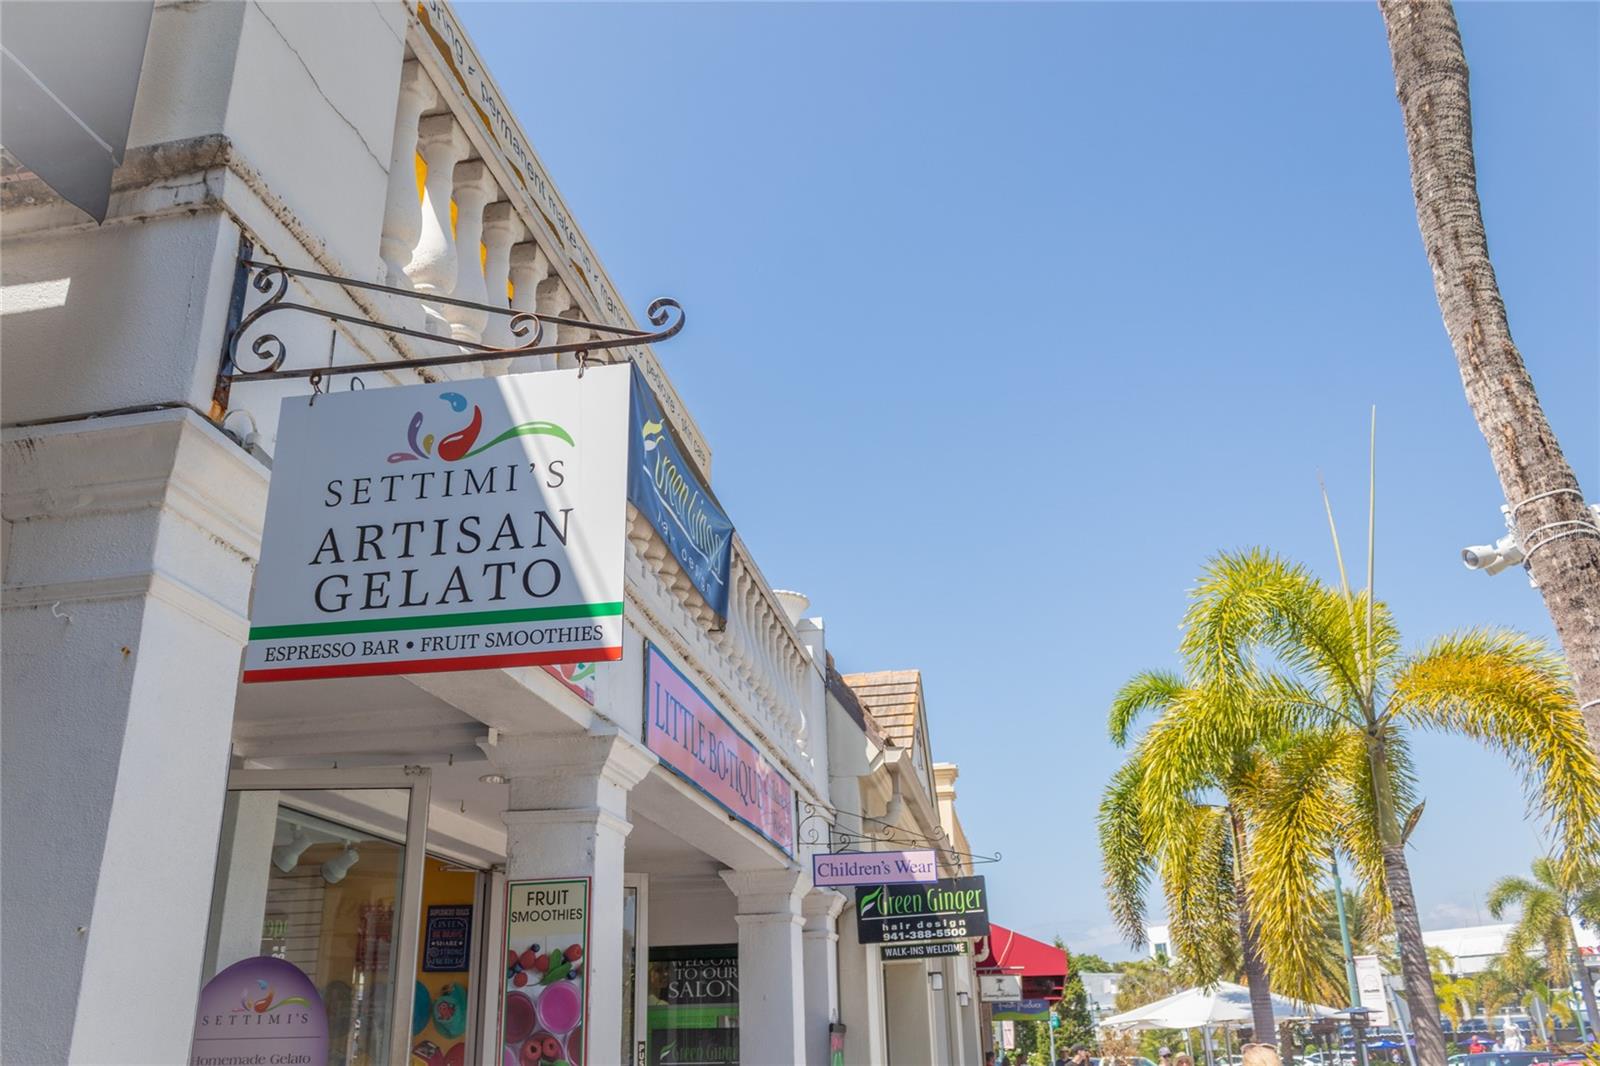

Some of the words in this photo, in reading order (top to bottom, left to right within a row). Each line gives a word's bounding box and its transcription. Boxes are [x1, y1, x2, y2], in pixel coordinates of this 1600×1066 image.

[480, 80, 547, 199] permanent
[324, 460, 566, 507] SETTIMI'S
[308, 508, 574, 566] ARTISAN
[313, 558, 562, 613] GELATO
[264, 641, 356, 662] ESPRESSO
[362, 638, 400, 656] BAR
[420, 633, 480, 652] FRUIT
[484, 624, 604, 648] SMOOTHIES
[655, 681, 706, 764] LITTLE
[817, 860, 891, 878] Children's
[895, 860, 934, 875] Wear
[526, 890, 569, 906] FRUIT
[876, 890, 922, 917] Green
[927, 888, 982, 915] Ginger
[511, 908, 583, 923] SMOOTHIES
[882, 922, 911, 931] hair
[917, 919, 966, 930] design
[883, 928, 967, 942] 941-388-5500
[885, 946, 924, 957] WALK-INS
[926, 943, 965, 954] WELCOME
[672, 958, 738, 967] WELCOM
[674, 967, 698, 980] TO
[703, 966, 738, 980] OUR
[668, 980, 739, 999] SALON
[202, 1013, 309, 1026] SETTIMI'S
[270, 1054, 312, 1065] Gelato
